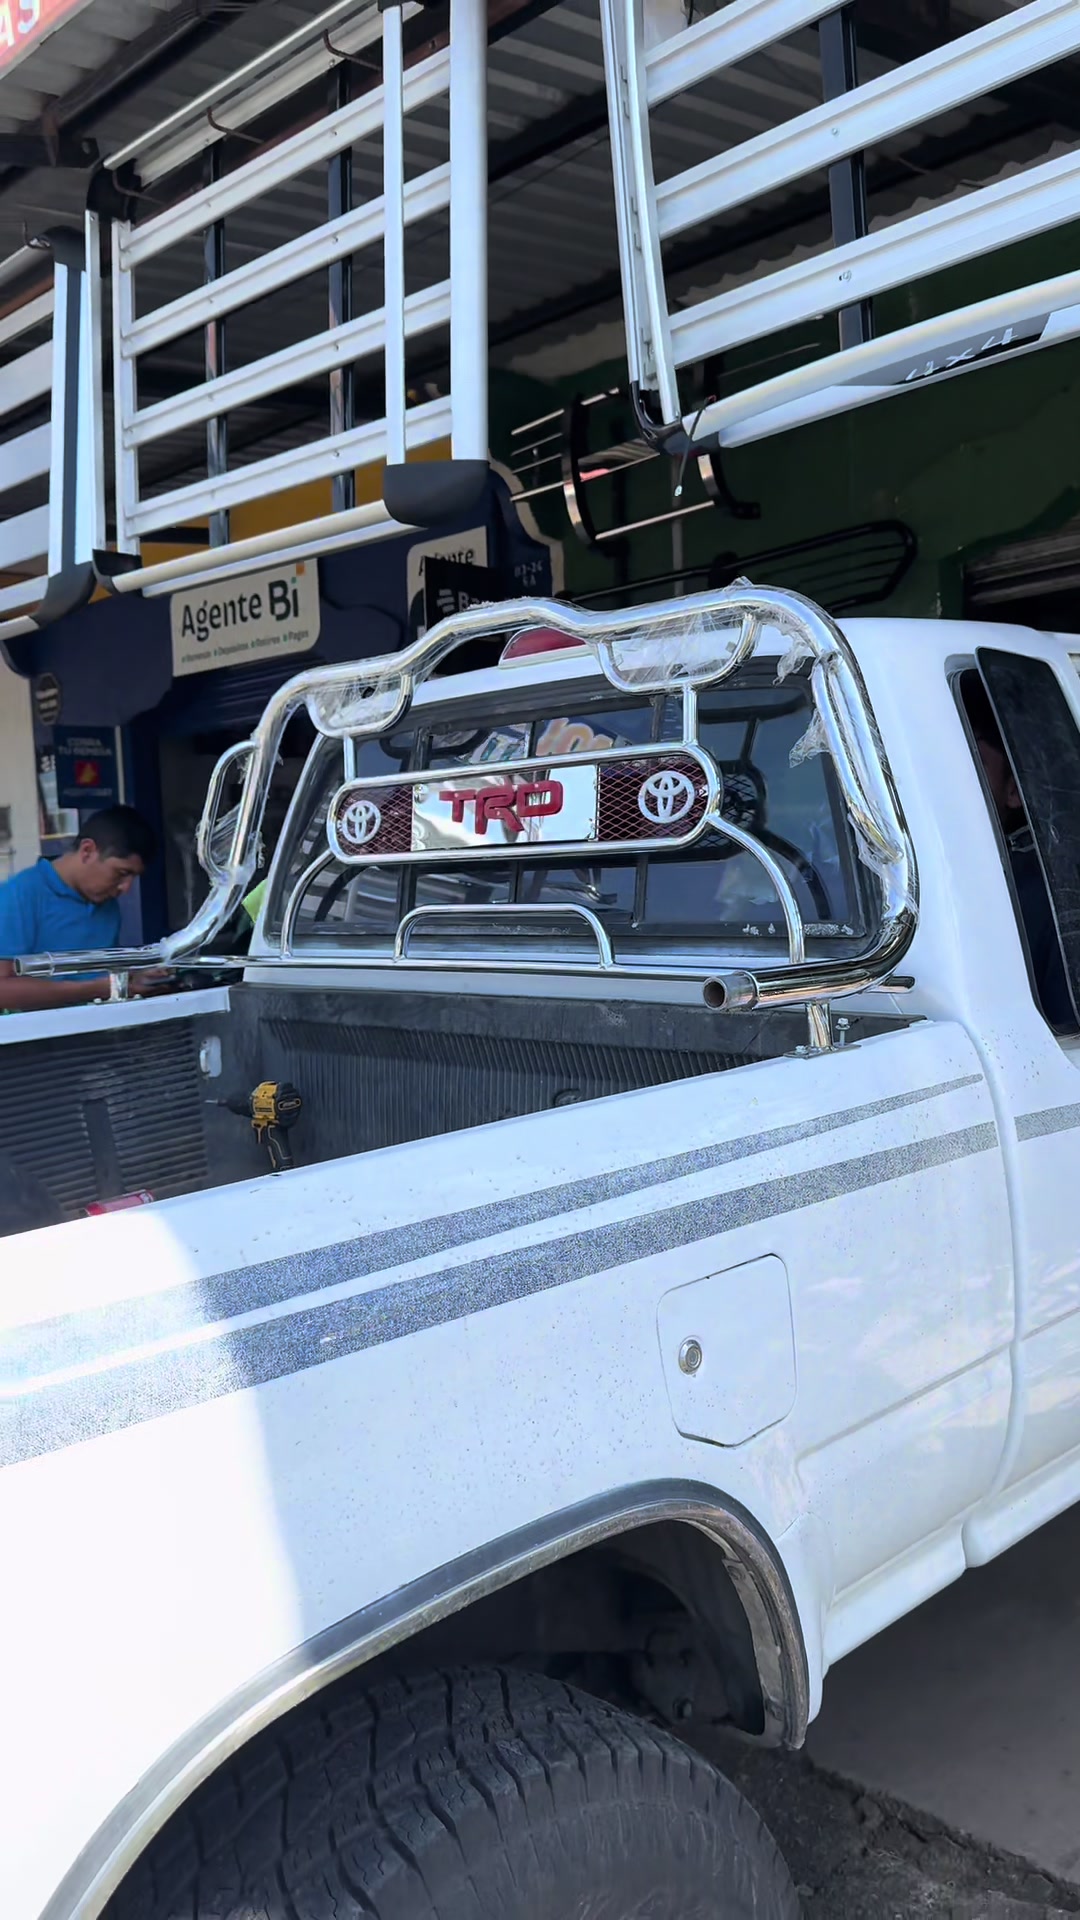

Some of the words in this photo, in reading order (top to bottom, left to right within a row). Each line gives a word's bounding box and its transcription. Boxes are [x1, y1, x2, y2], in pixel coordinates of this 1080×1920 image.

[181, 593, 262, 642] Agente
[268, 576, 299, 621] Bi
[439, 779, 564, 835] TRD
